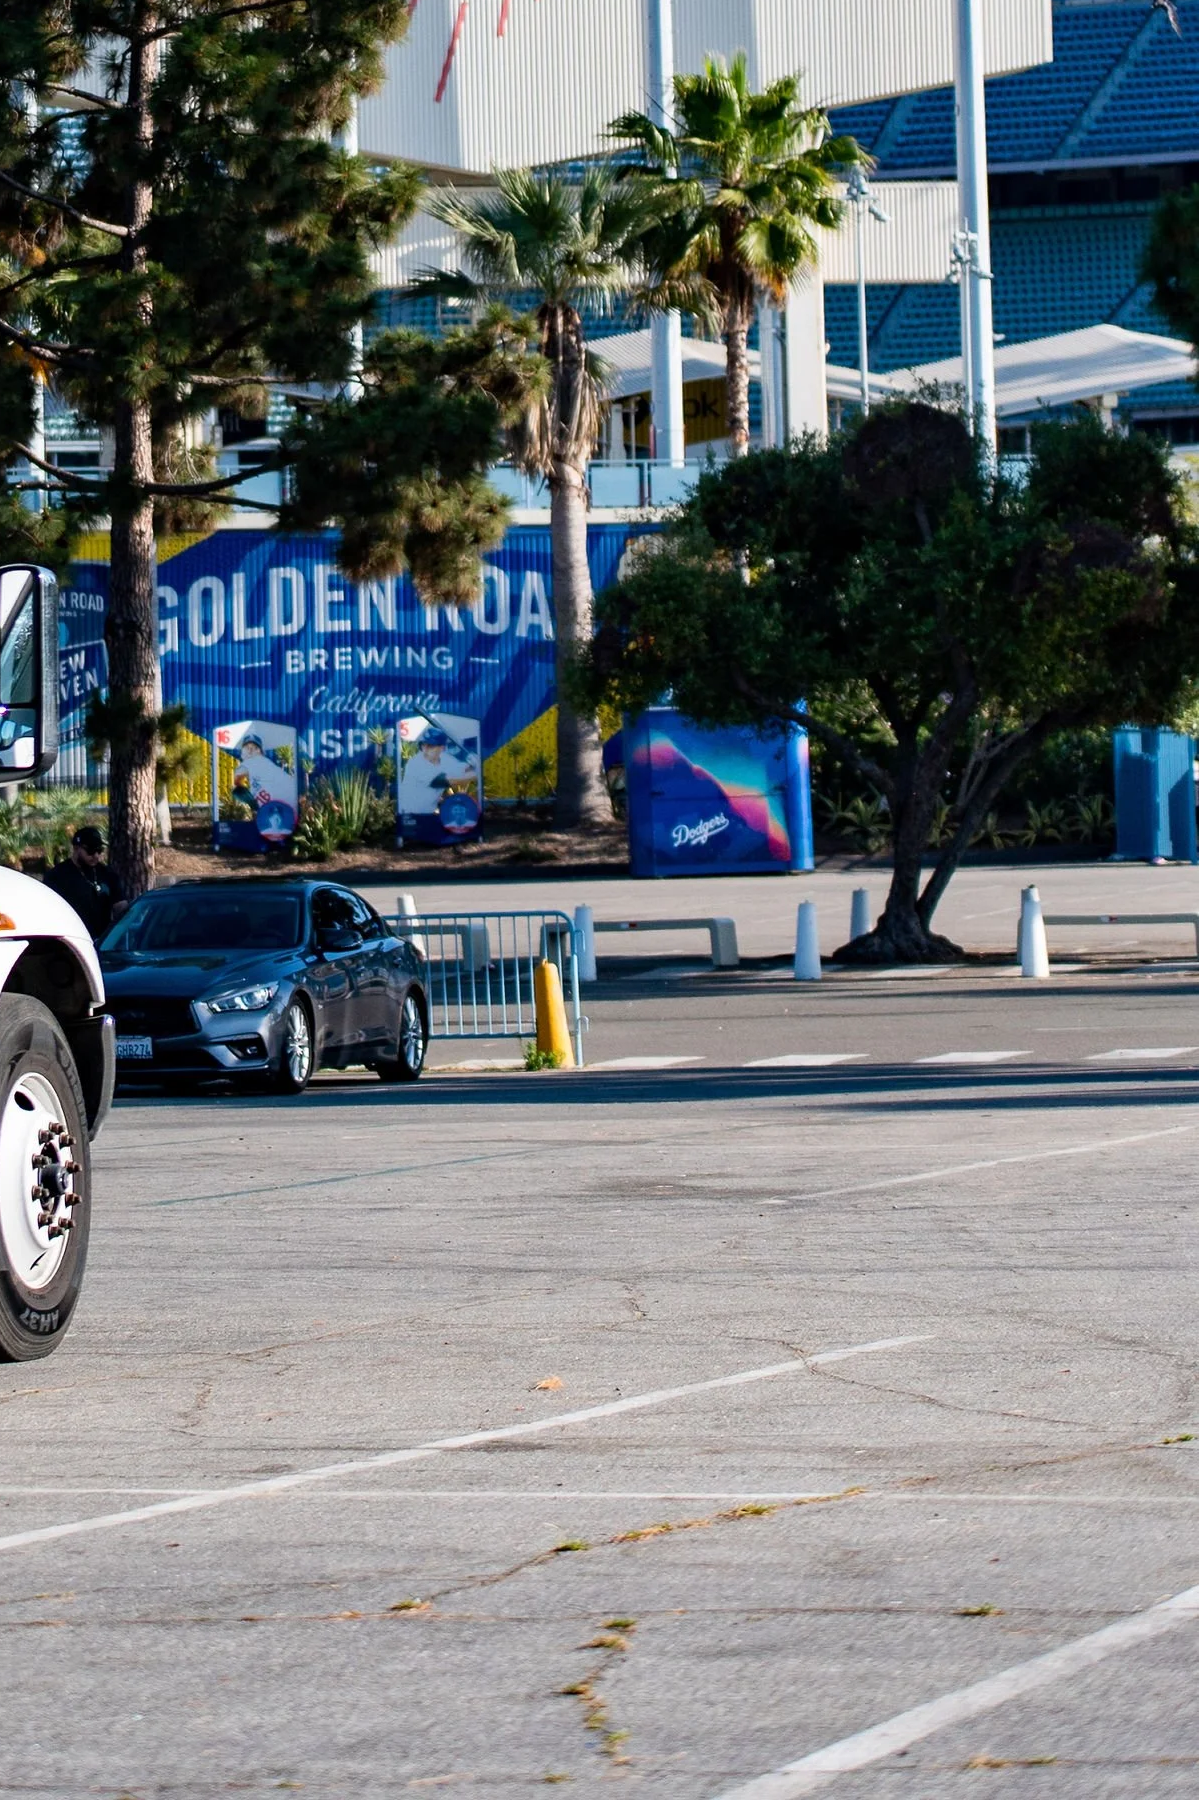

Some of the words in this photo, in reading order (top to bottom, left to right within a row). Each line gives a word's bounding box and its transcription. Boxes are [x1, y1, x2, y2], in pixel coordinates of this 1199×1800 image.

[71, 591, 105, 612] ROAD
[157, 564, 398, 656] GOLDEN
[285, 646, 454, 675] BREWING
[308, 684, 442, 725] California
[216, 729, 231, 745] 16
[672, 811, 730, 848] Dodgers
[19, 1307, 60, 1333] AH37
